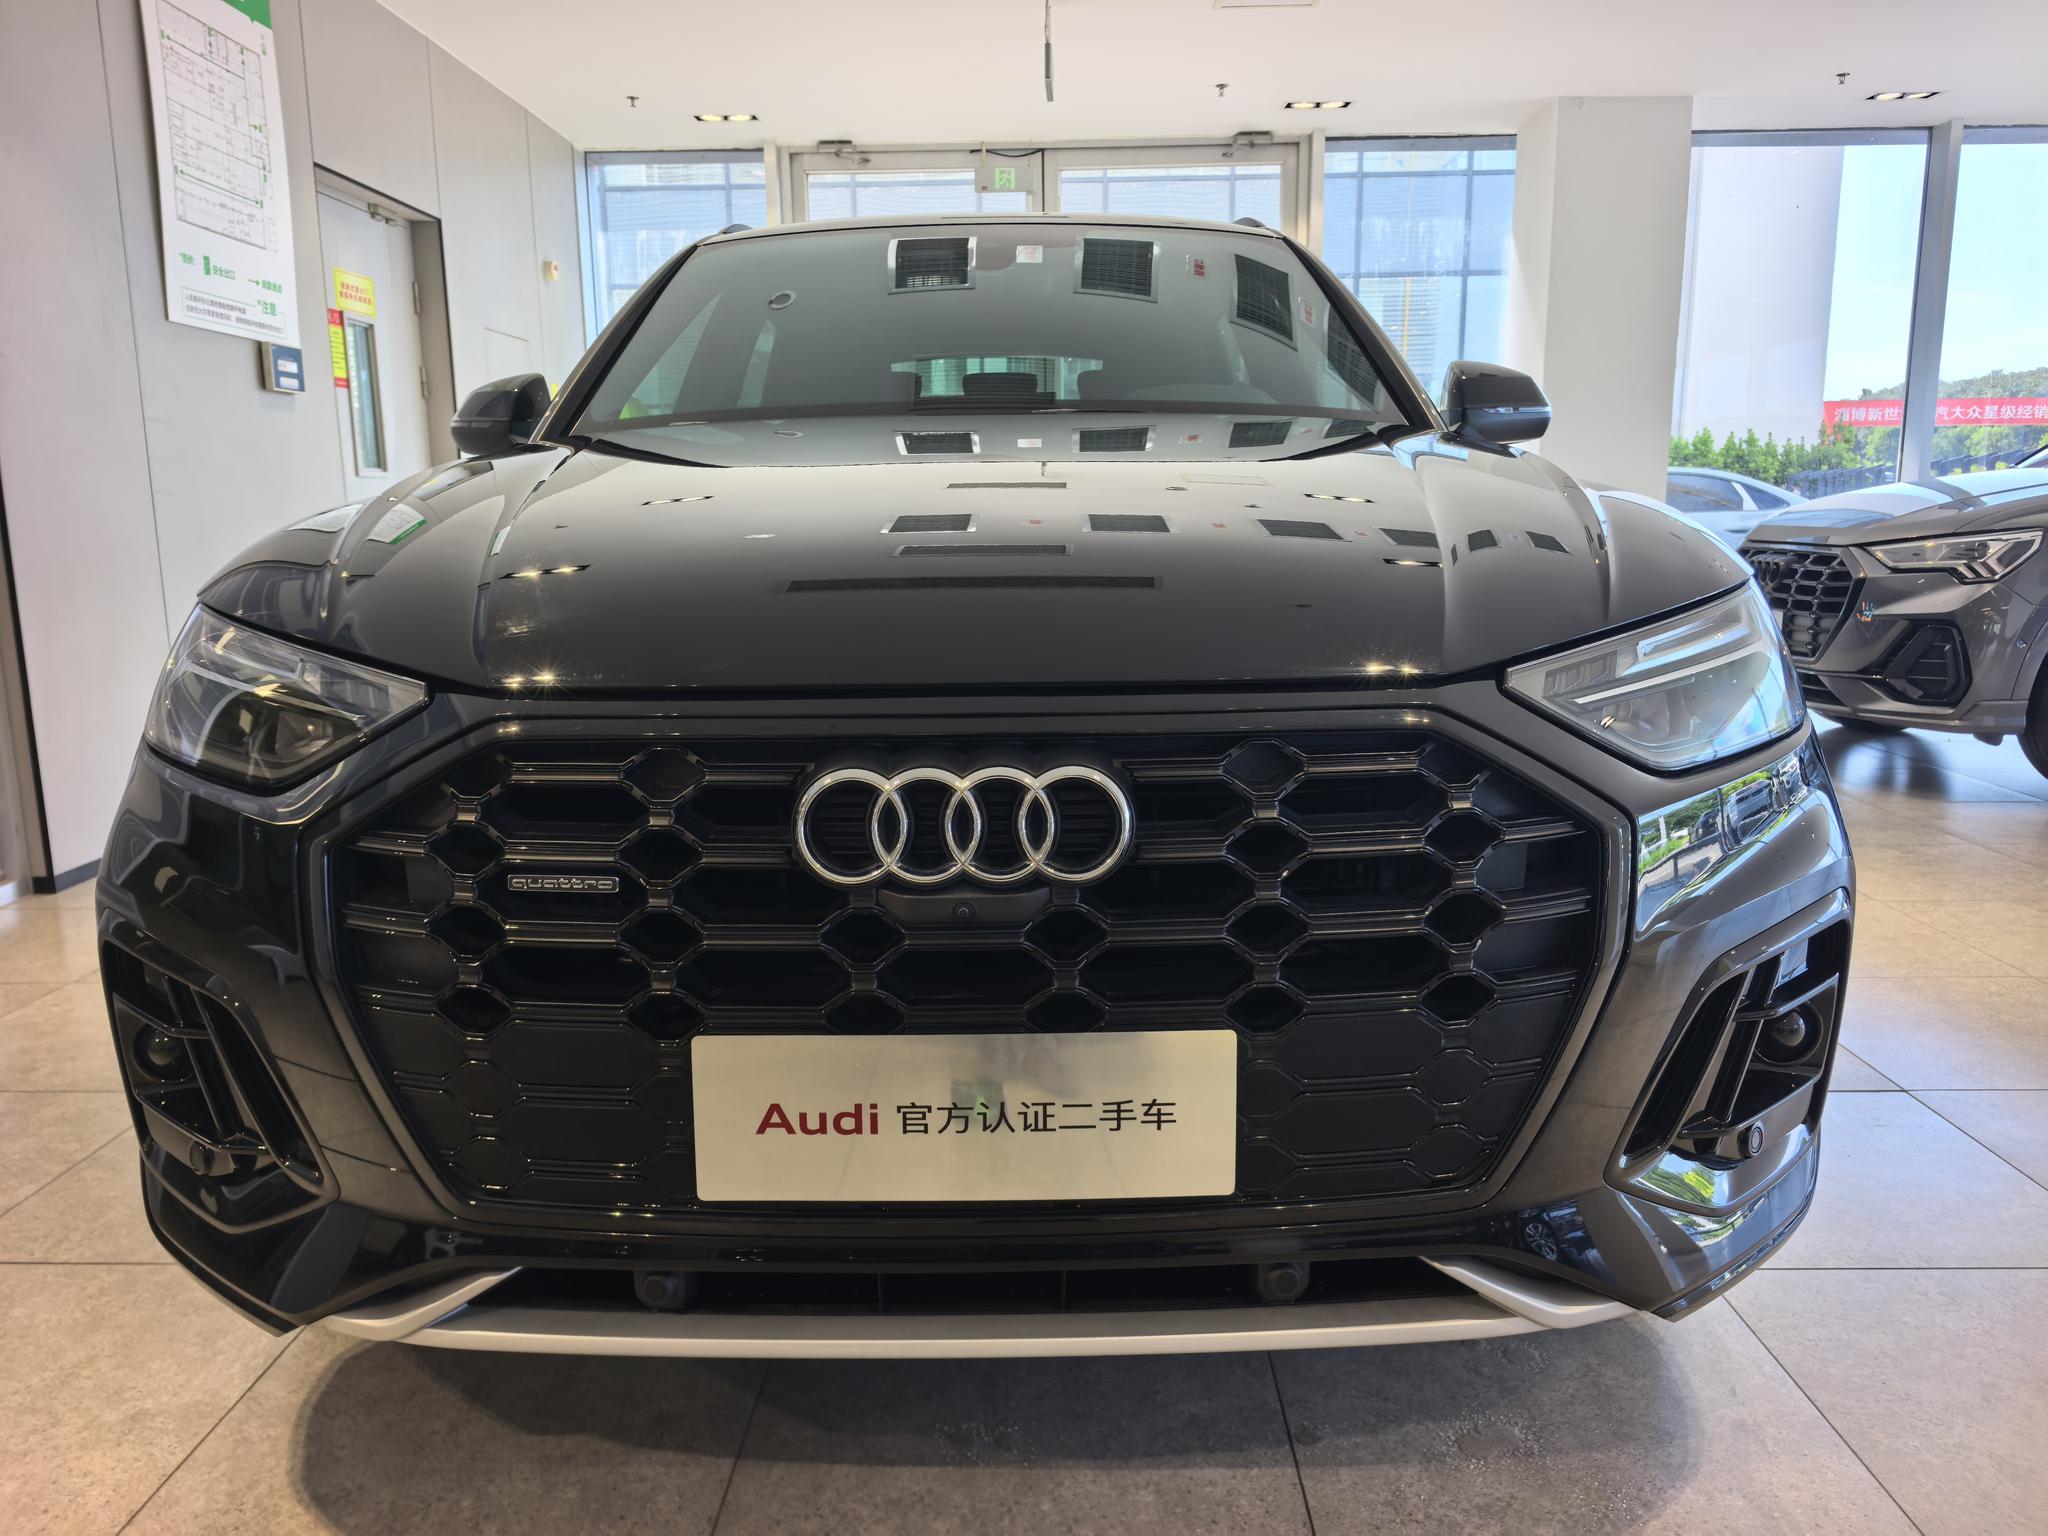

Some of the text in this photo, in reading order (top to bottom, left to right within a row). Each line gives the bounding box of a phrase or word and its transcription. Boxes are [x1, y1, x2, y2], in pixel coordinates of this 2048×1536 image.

[1834, 406, 1904, 422] 淄博新世
[511, 877, 613, 889] quattro
[755, 1098, 1177, 1136] Audi 官方认证二手车
